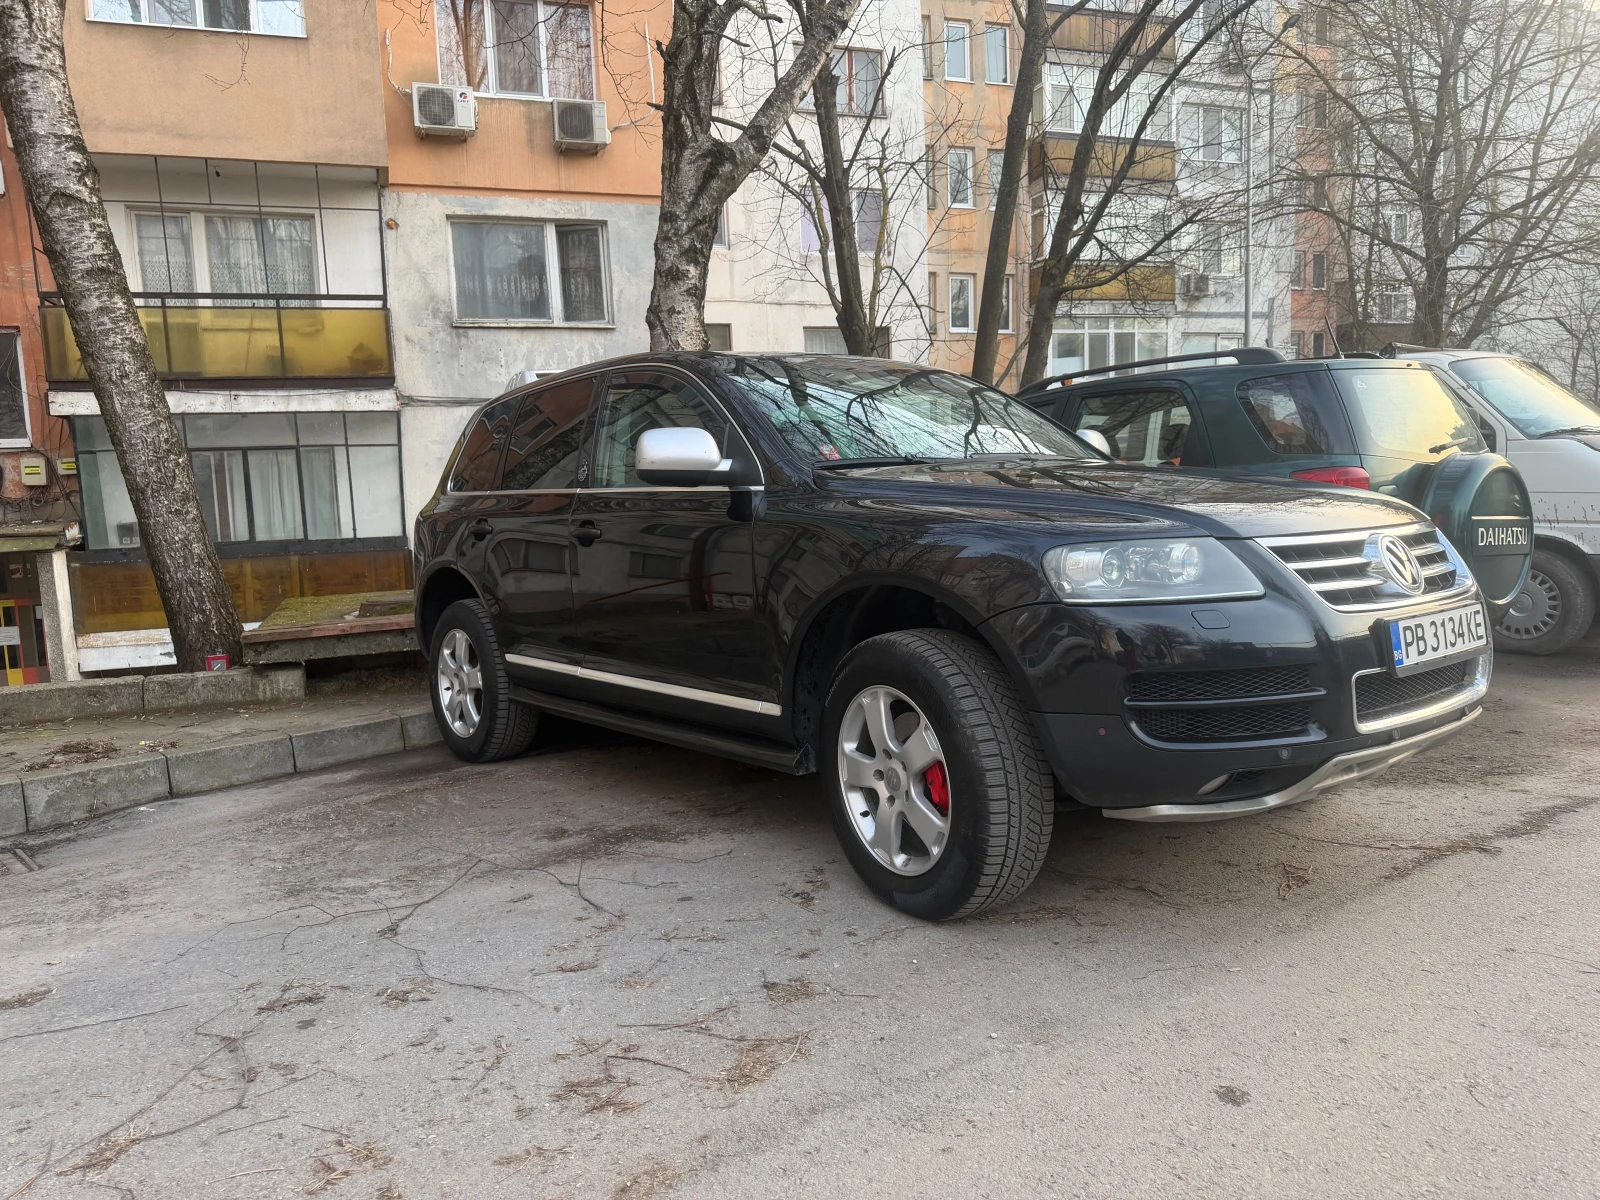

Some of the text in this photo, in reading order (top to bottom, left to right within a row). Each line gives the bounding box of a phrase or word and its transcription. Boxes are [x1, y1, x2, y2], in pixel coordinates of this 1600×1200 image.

[1478, 527, 1528, 546] DAIHATSU
[1402, 609, 1484, 659] PB 3134 KE
[1394, 650, 1403, 661] BG
